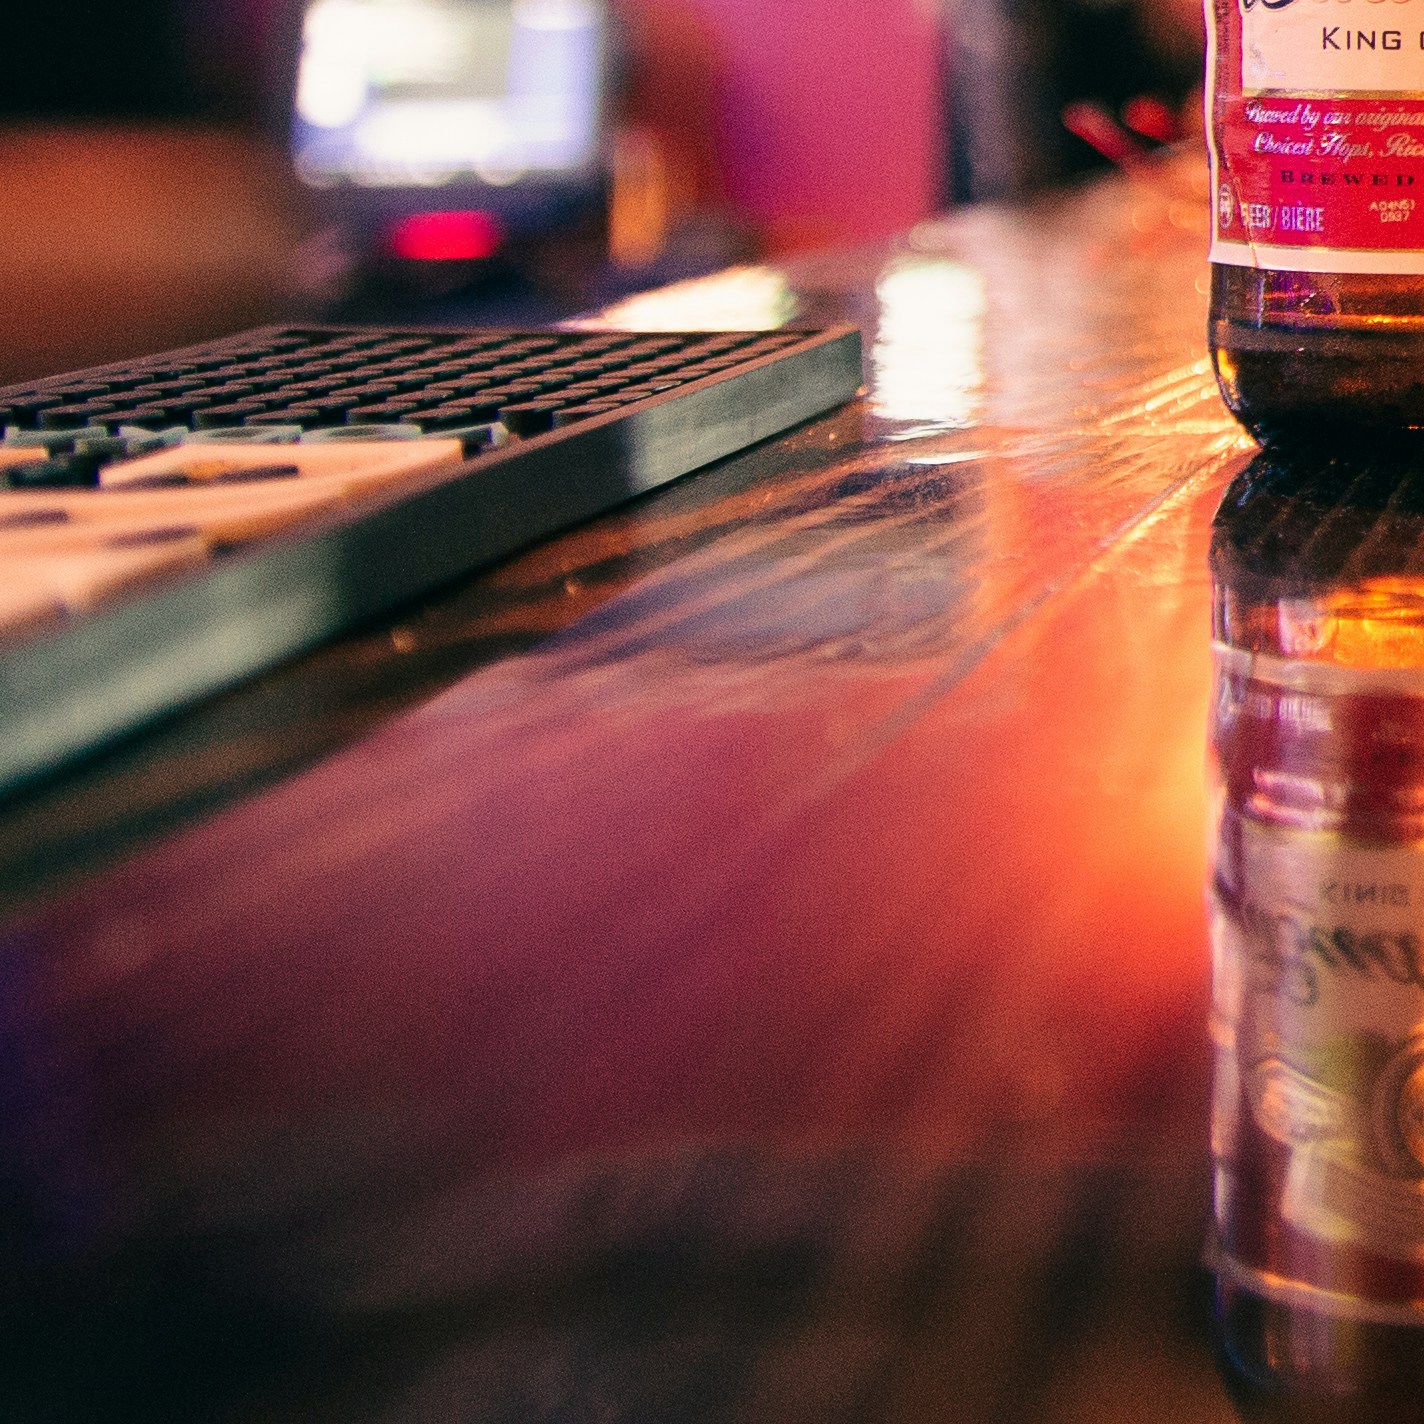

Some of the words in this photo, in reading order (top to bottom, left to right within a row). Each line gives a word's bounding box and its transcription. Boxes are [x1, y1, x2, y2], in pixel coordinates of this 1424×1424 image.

[1322, 26, 1401, 52] KING
[1245, 99, 1302, 124] Brewed
[1301, 103, 1321, 131] by
[1322, 110, 1352, 125] our
[1254, 130, 1314, 156] Choicest
[1280, 169, 1415, 187] BREWED
